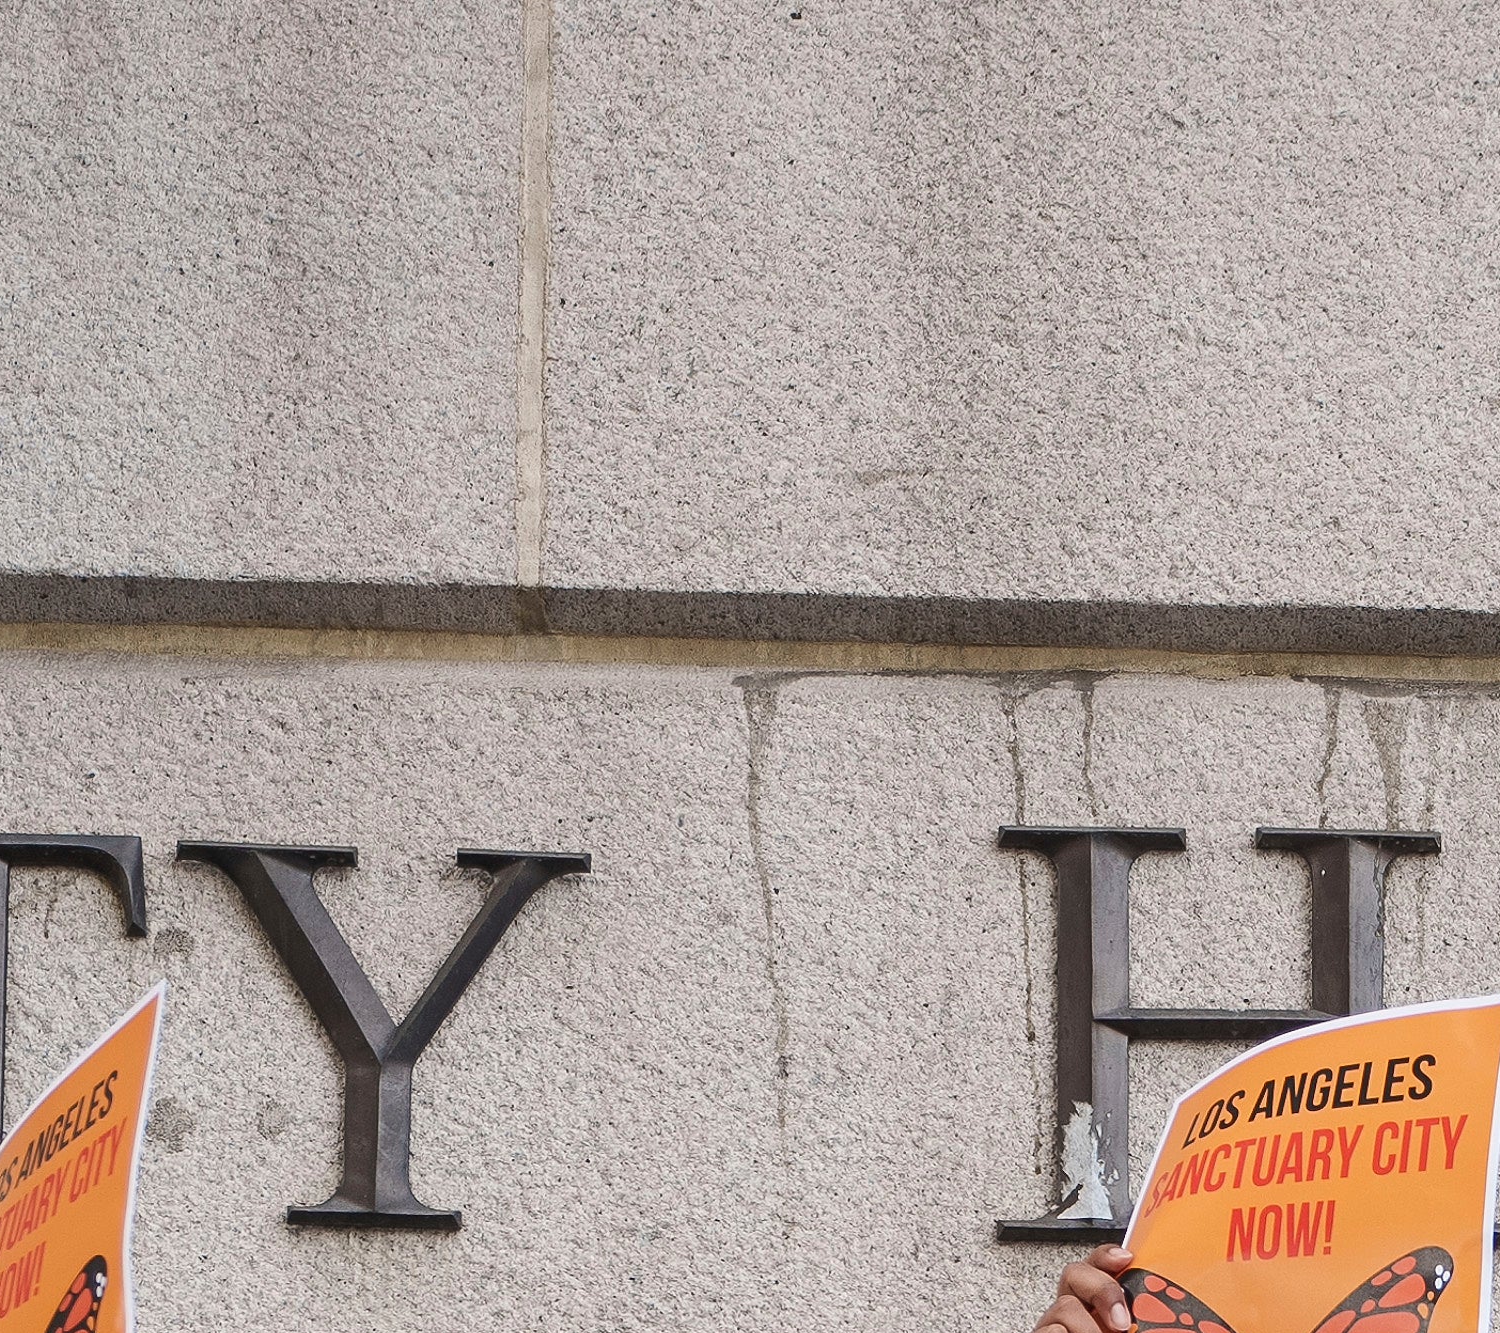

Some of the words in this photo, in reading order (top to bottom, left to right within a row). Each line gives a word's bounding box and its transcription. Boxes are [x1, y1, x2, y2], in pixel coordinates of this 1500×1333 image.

[14, 1070, 118, 1188] ANGELES
[1182, 1089, 1246, 1149] LOS
[1248, 1054, 1436, 1122] ANGELES
[69, 1116, 127, 1203] CITY
[1144, 1123, 1365, 1218] SANCTUARY
[1372, 1115, 1469, 1176] CITY
[1226, 1200, 1336, 1262] NOW!
